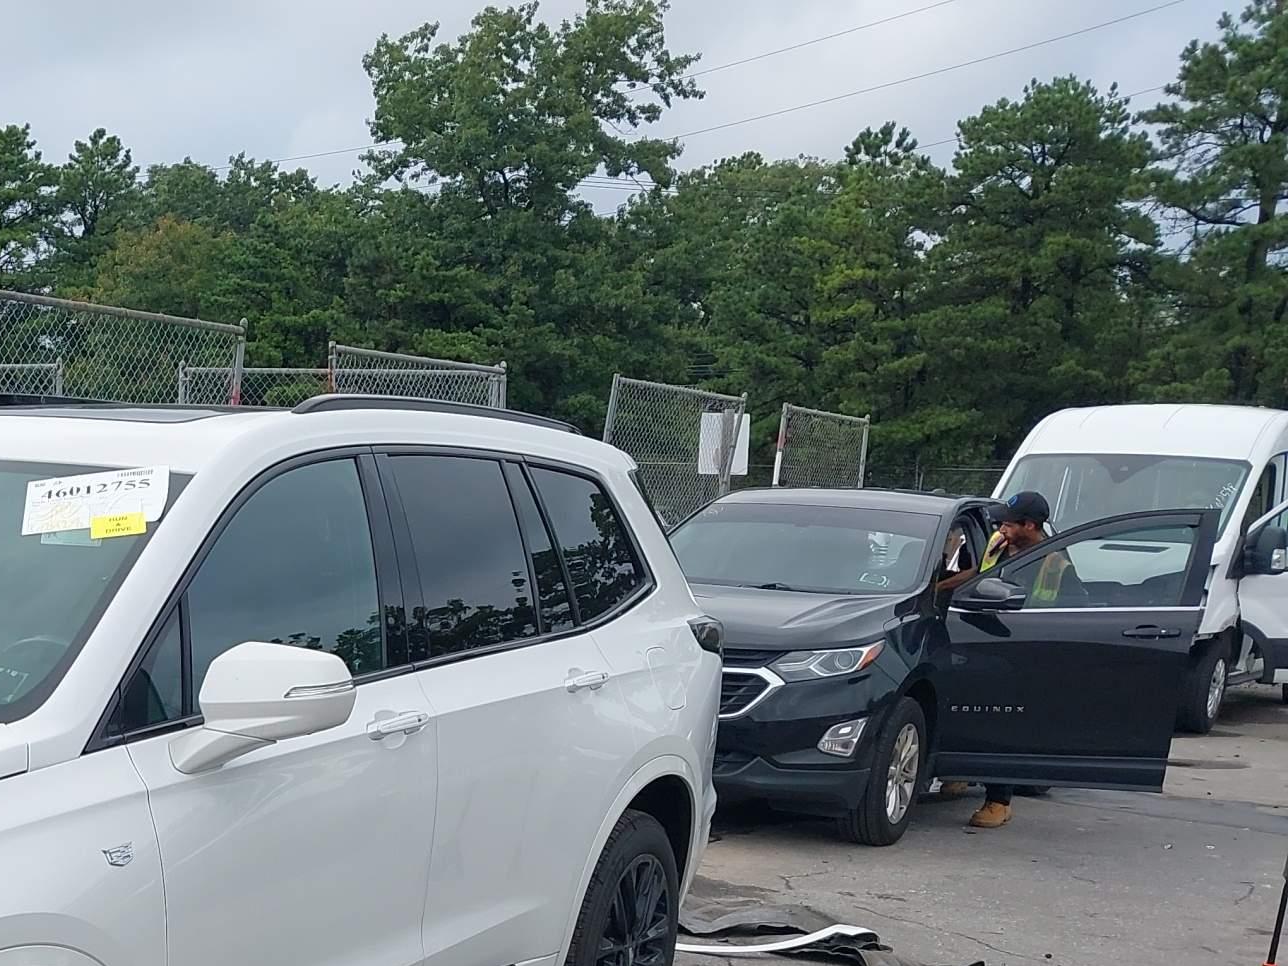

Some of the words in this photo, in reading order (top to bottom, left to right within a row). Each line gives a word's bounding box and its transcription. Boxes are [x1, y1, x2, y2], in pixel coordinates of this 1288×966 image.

[41, 478, 151, 500] 46012755
[105, 526, 132, 534] DRIVE
[951, 705, 1025, 713] EQUINOX
